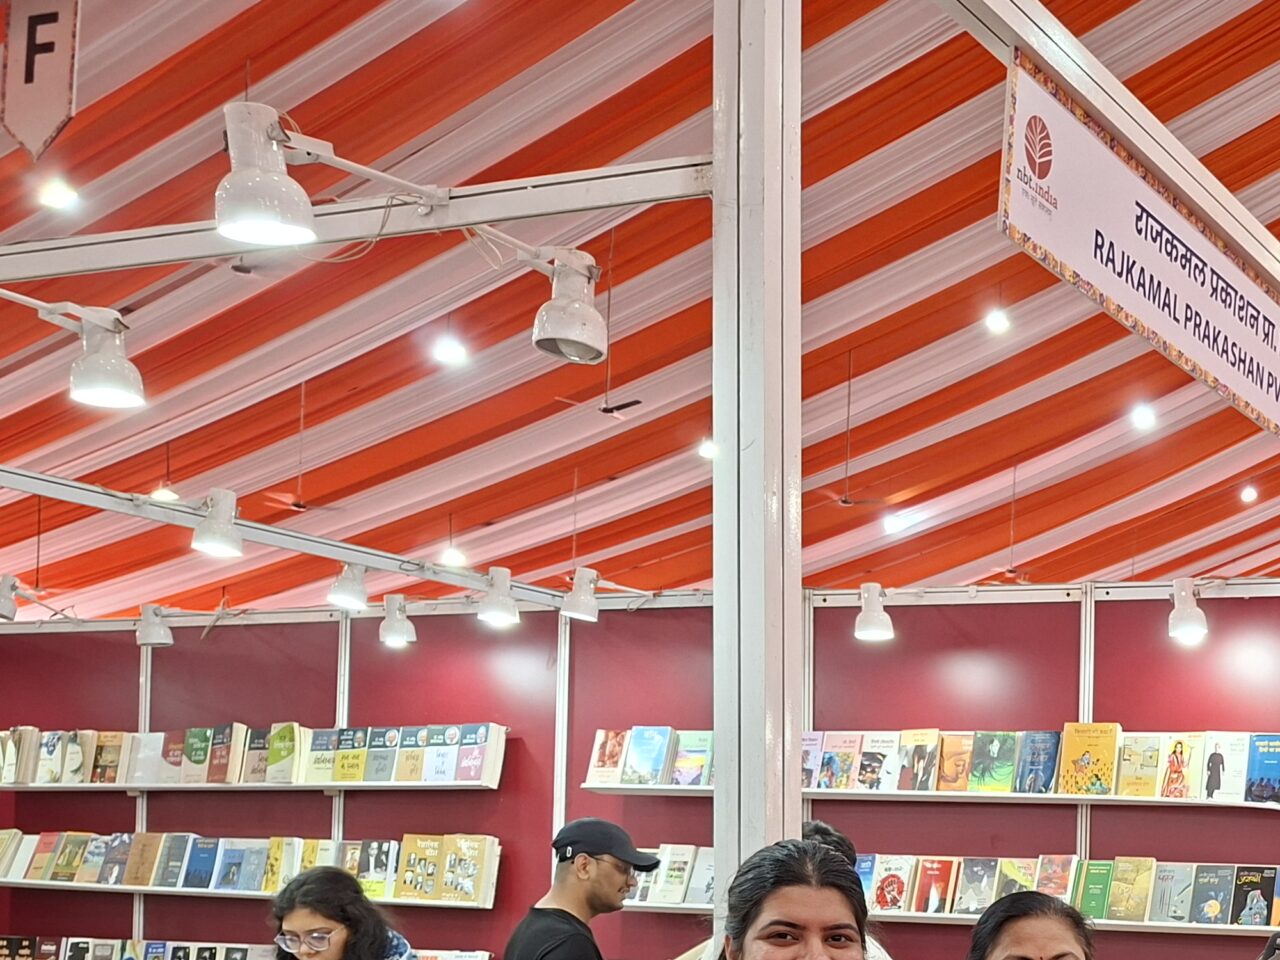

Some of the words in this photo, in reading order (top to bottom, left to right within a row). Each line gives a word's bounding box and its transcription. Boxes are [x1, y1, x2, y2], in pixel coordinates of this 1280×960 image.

[24, 11, 59, 84] F
[1093, 229, 1180, 324] RAJKAMAL
[1184, 303, 1264, 390] PRAKASHAN
[1135, 200, 1208, 287] राजकमल
[1210, 267, 1261, 336] प्रकाशन
